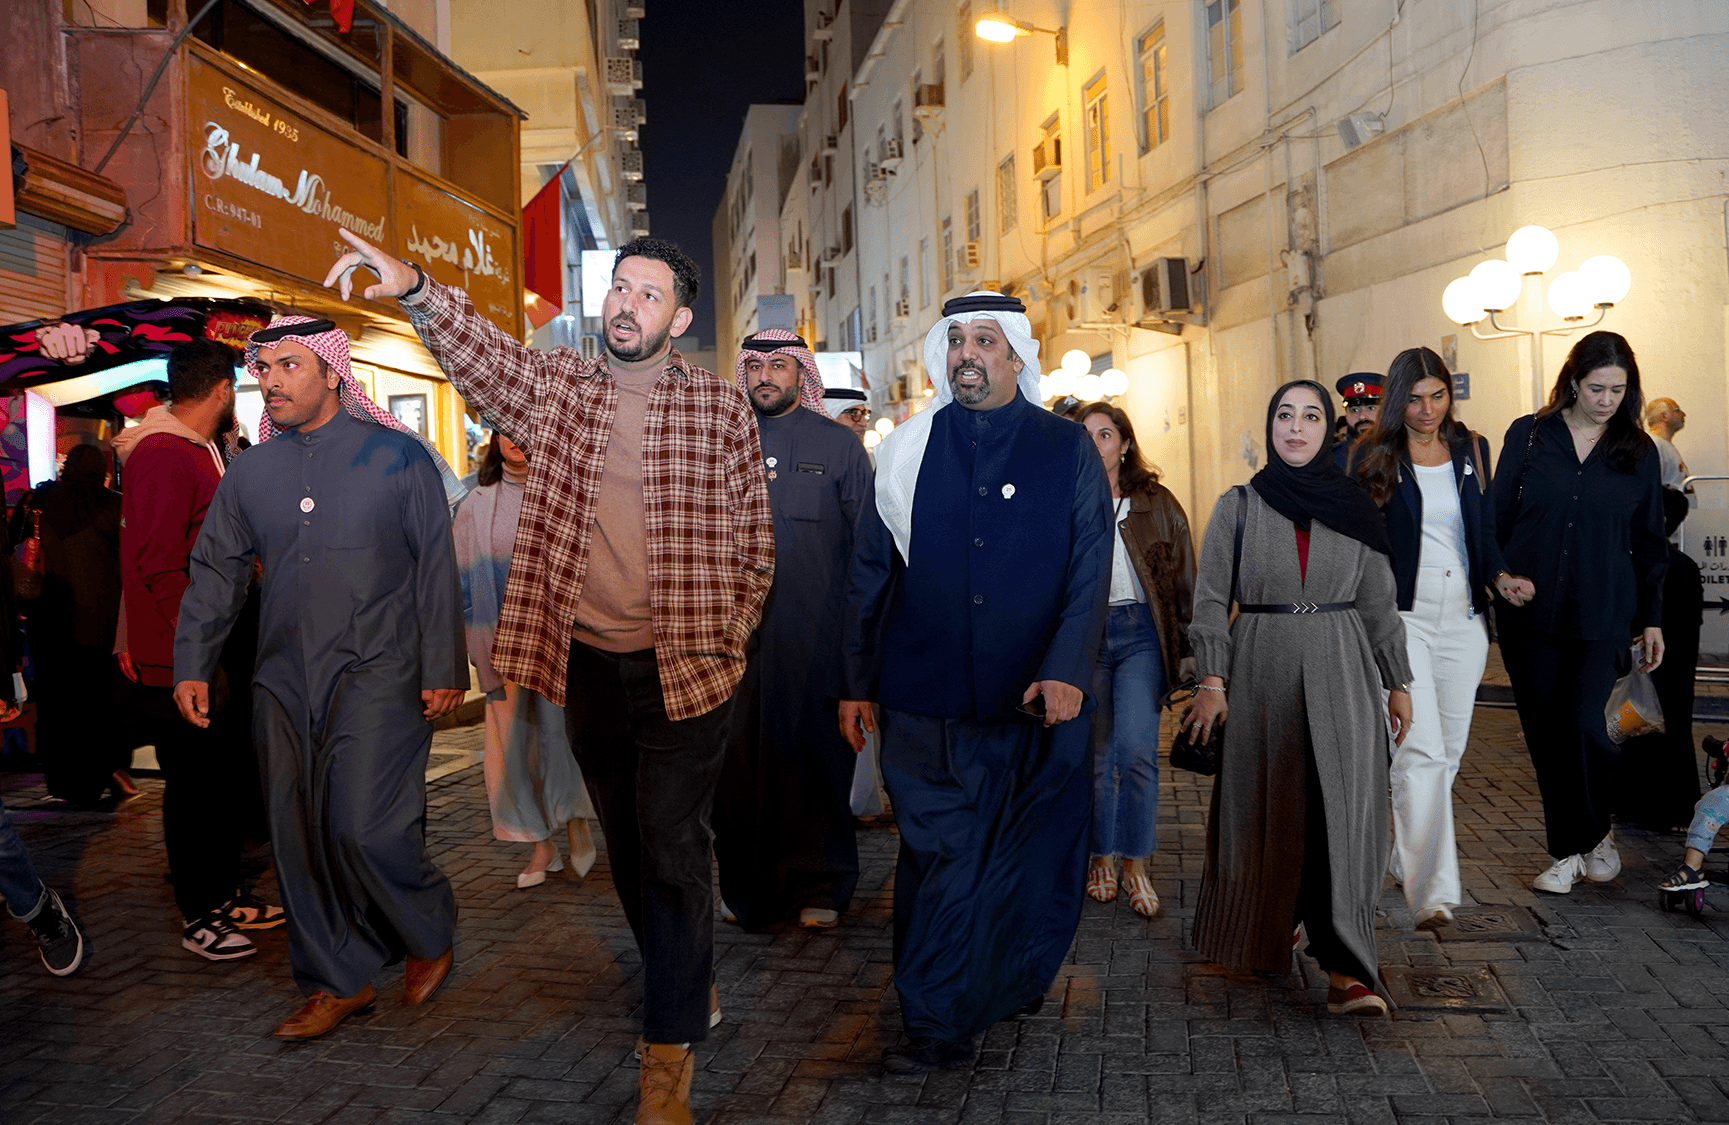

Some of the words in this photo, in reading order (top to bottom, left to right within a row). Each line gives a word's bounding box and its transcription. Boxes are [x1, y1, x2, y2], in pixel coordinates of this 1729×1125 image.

[222, 86, 270, 127] Established
[273, 119, 299, 142] 1935
[202, 121, 284, 198] Ghulam
[284, 169, 385, 243] Mohammed
[406, 224, 459, 266] محمد
[462, 228, 494, 290] غلام
[1700, 575, 1729, 584] OILET
